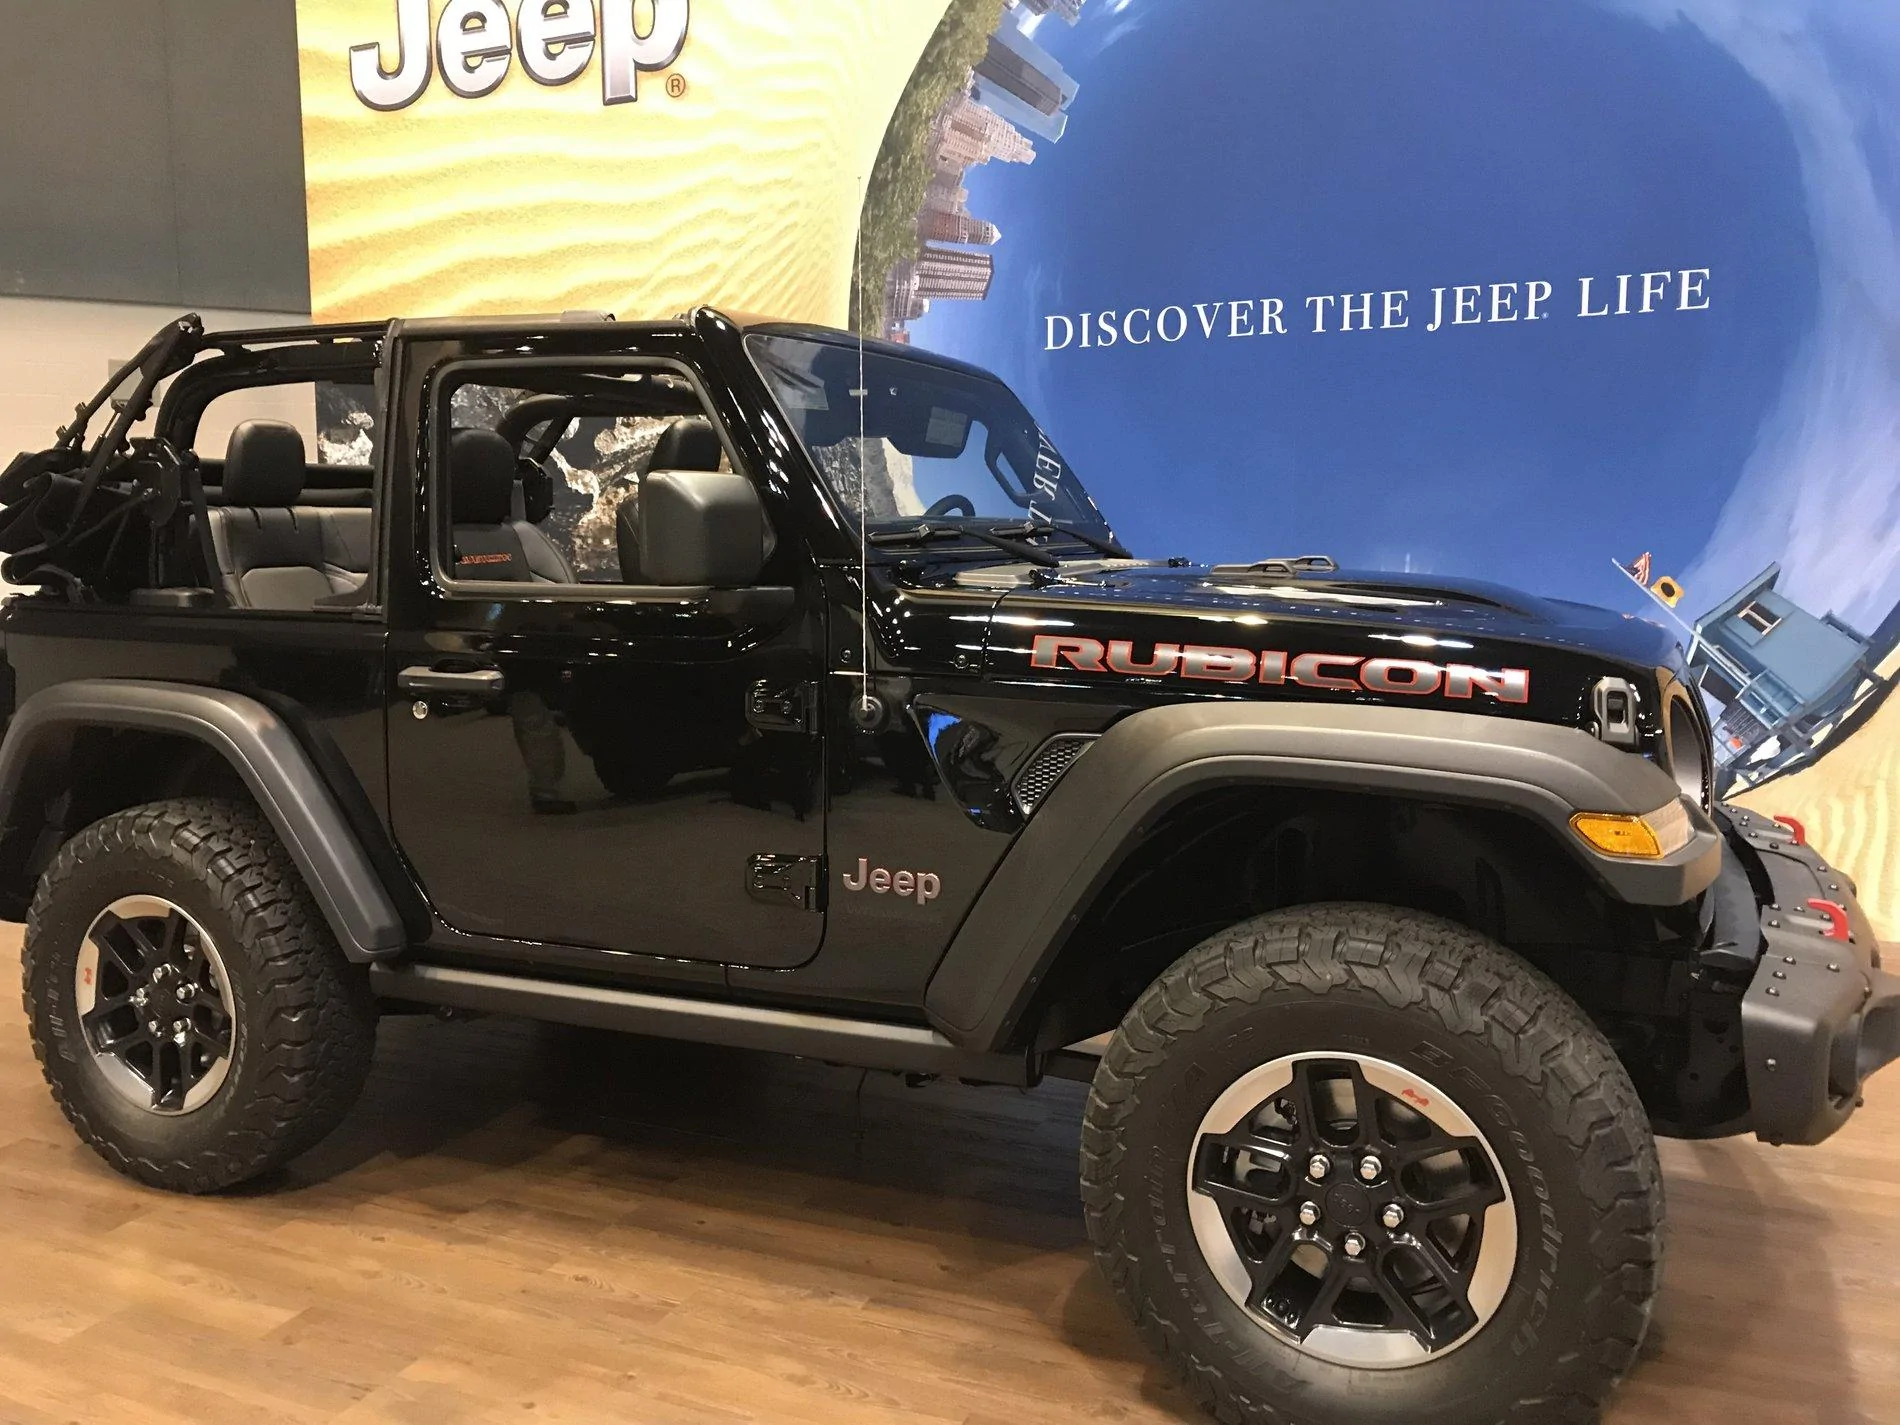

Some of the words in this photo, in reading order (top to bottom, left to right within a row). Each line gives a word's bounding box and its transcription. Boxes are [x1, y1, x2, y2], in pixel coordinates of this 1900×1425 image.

[349, 0, 690, 112] Jeep
[1044, 297, 1288, 351] DISCOVER
[1305, 288, 1410, 334] THE
[1426, 279, 1553, 332] JEEP
[1578, 268, 1711, 318] LIFE
[1029, 634, 1530, 704] RUBICON
[842, 857, 941, 905] Jeep
